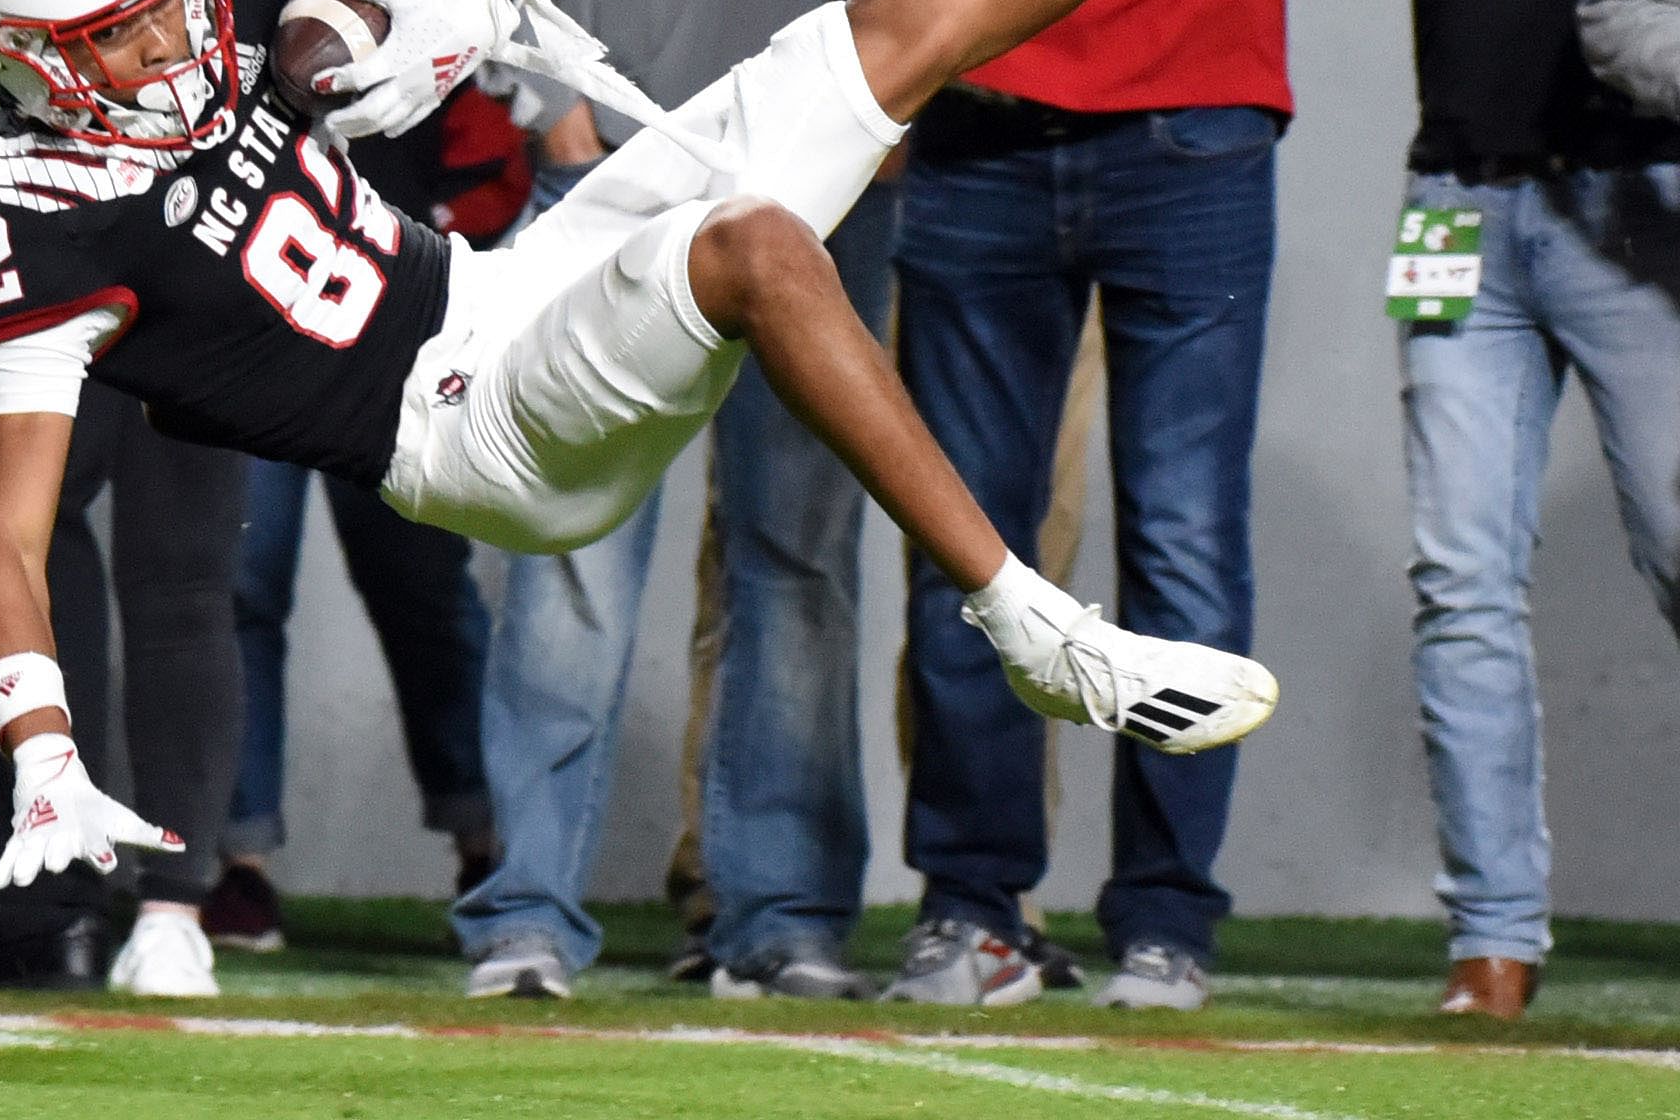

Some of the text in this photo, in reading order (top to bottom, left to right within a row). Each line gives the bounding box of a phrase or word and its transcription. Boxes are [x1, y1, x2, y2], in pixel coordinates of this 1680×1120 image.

[239, 42, 267, 95] adidas
[192, 92, 295, 257] NC STAT
[240, 132, 401, 349] 82
